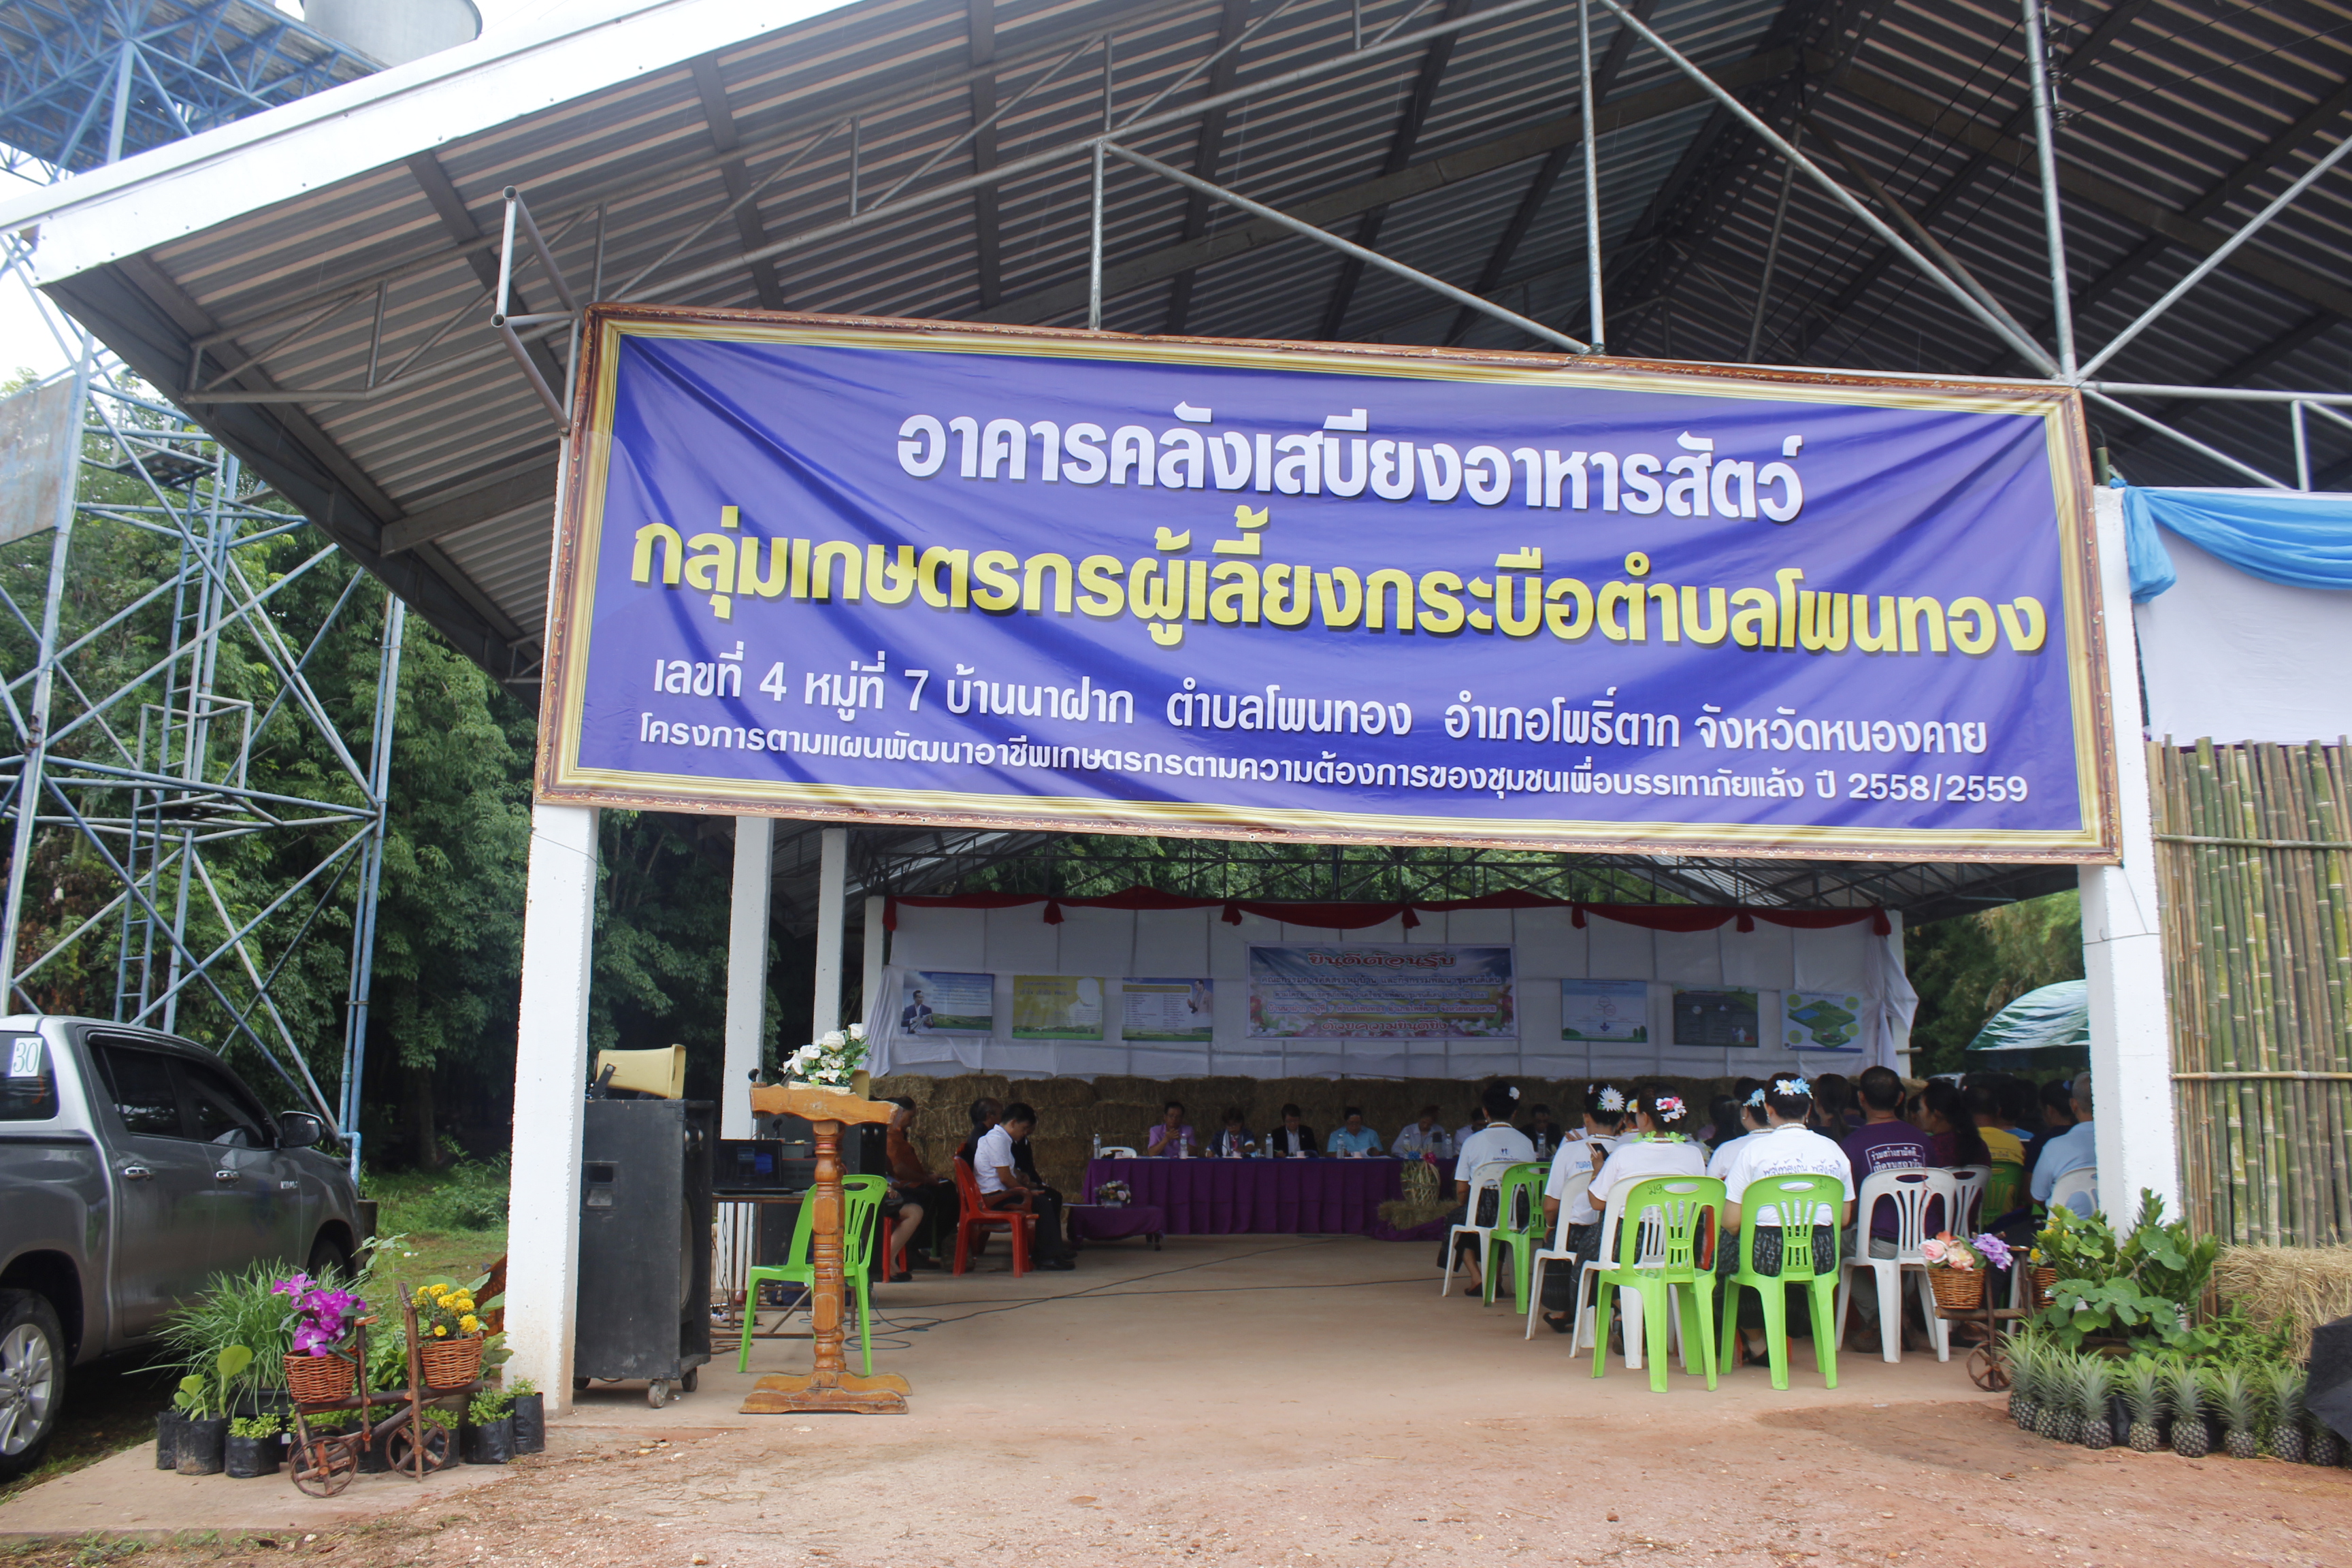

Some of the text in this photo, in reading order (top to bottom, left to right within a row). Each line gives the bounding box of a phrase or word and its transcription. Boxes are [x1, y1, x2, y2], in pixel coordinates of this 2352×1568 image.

[898, 400, 1803, 523] อาคารคลังเสบียงอาหารสัตว์
[632, 506, 2046, 655] กลุ่มเกษตรกรผู้เลี้ยงกระบือตำบลโพนทอง
[654, 640, 1987, 753] เลขที่ 4 หมู่ที่ 7 บ้านนาฝาก ตำบลโพนทอง อำเภอโพธิ์ตาก จังหวัดหนองคาย
[640, 712, 2027, 802] โครงการตามแผนพัฒนาอาชีพเกษตรกรตามความต้องการของชุมชนเพื่อบรรเทาภัยแล้ง ปี 2558/2559
[1307, 951, 1455, 969] ยินดีต้อนรับ
[14, 1043, 39, 1073] 30
[1322, 1019, 1448, 1032] ด้วยความยินดียิ่ง
